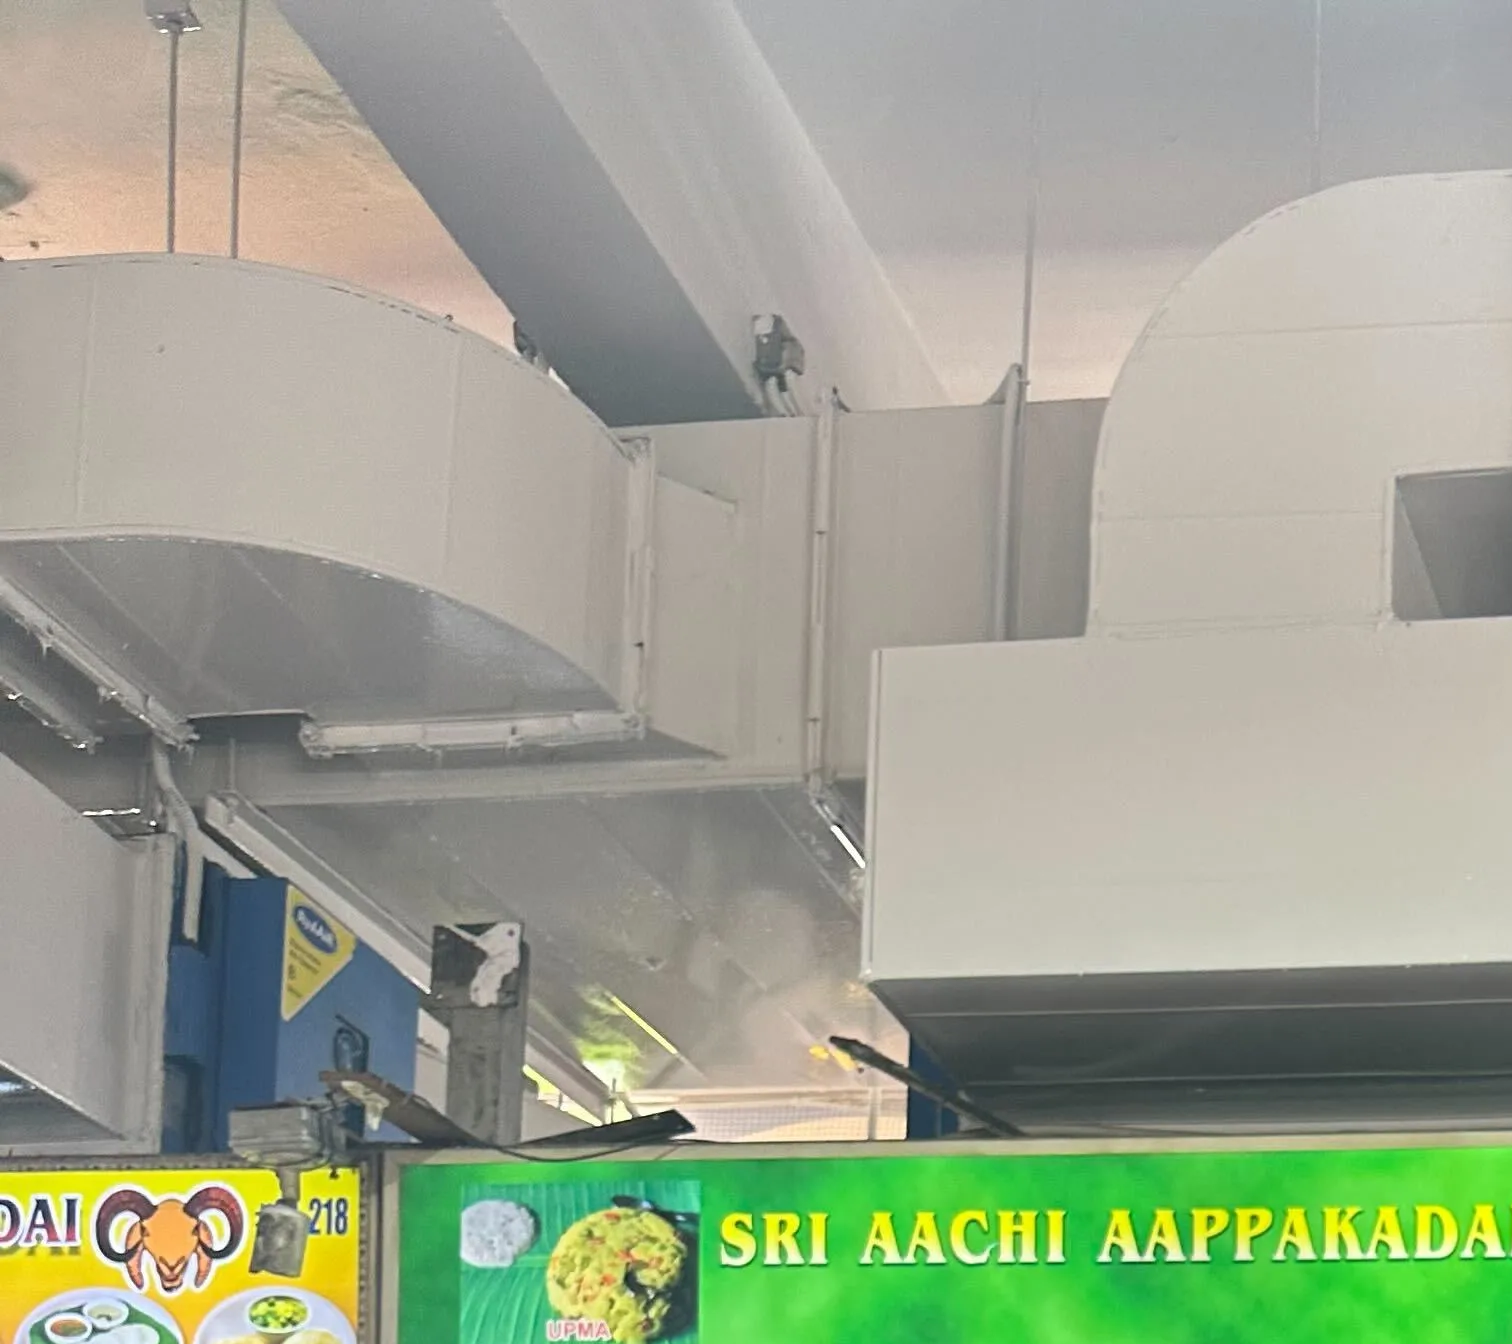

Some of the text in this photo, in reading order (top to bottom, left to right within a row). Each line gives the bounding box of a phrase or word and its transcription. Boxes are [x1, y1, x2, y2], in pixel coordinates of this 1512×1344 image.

[720, 1211, 829, 1267] SRI
[858, 1209, 1067, 1266] AACHI
[547, 1321, 611, 1340] UPMA
